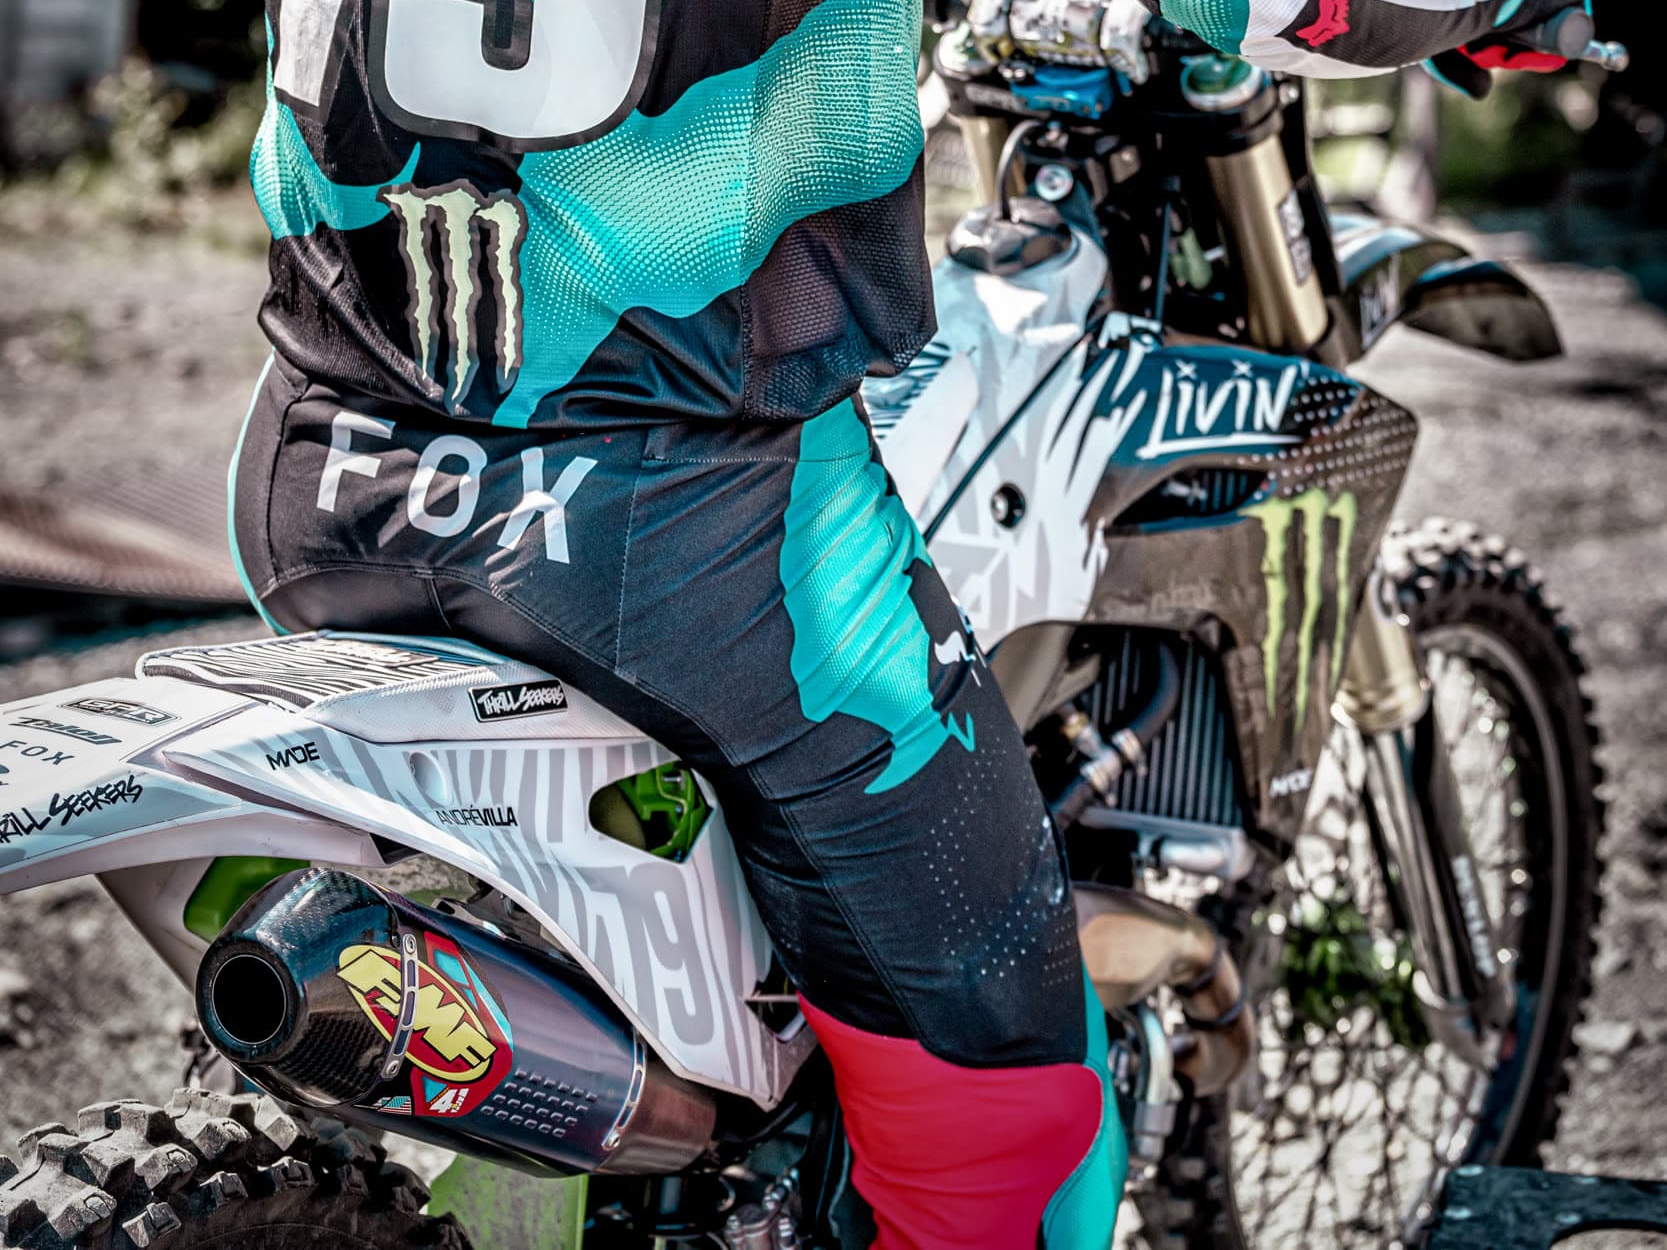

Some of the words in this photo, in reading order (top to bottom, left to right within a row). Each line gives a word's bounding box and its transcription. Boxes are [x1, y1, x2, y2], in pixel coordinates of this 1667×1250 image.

[317, 412, 598, 564] FOX
[0, 740, 74, 765] FOX
[265, 742, 320, 771] MADE
[0, 807, 51, 844] RILL
[49, 775, 143, 826] SEEKERS
[572, 862, 715, 1046] 79
[336, 948, 497, 1070] FMF
